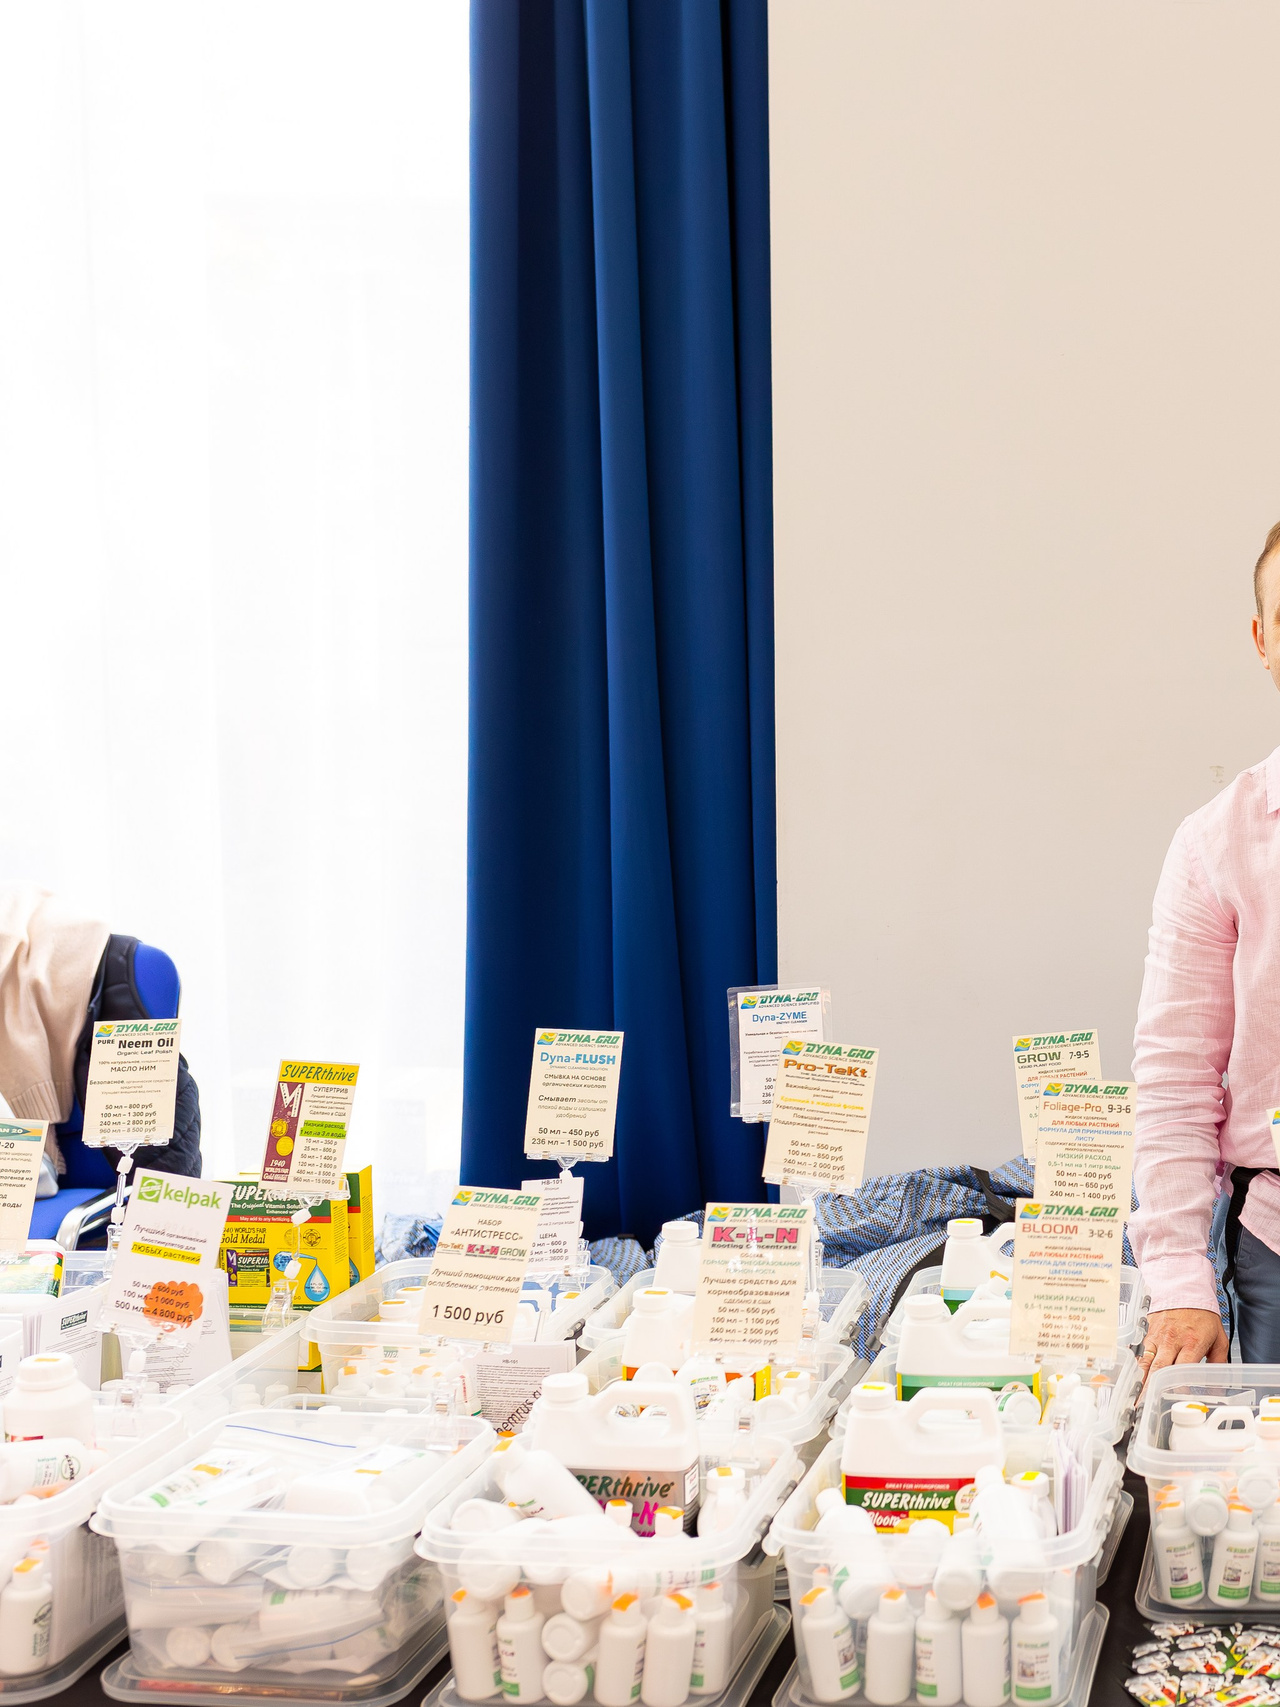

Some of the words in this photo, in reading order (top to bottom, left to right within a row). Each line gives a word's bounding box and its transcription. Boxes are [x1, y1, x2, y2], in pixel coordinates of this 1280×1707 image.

[759, 992, 819, 1004] DYNA-GRO
[753, 1011, 807, 1023] Dyna-ZYME
[116, 1023, 178, 1032] DYNA-GRO
[119, 1040, 152, 1048] Neem
[157, 1038, 173, 1047] Oil
[558, 1033, 620, 1044] DYNA-GRO
[1034, 1032, 1093, 1045] DYNA-GRO
[806, 1043, 876, 1059] DYNA-GRO
[540, 1052, 616, 1065] Dyna-FLUSH
[1017, 1051, 1061, 1064] GROW
[1069, 1051, 1089, 1059] 7-9-5
[282, 1064, 355, 1081] SUPERthrive
[1065, 1084, 1130, 1095] DYNA-GRO
[538, 1095, 576, 1103] Смывает
[1043, 1101, 1102, 1113] Foliage-Pro
[1108, 1105, 1131, 1113] 9-3-6
[1085, 1154, 1111, 1162] РАСХОД
[163, 1183, 222, 1209] kelpak
[474, 1192, 541, 1206] DYNA-GRO
[733, 1208, 808, 1218] DYNA-GRO
[1044, 1205, 1119, 1217] DYNA-GRO
[451, 1228, 523, 1241] «АНТИСТРЕСС»
[713, 1227, 798, 1243] K-L-N
[1022, 1223, 1078, 1234] BLOOM
[1089, 1229, 1113, 1238] 3-12-6
[241, 1234, 265, 1244] Medal
[703, 1276, 736, 1285] Лучшее
[739, 1277, 779, 1286] средство
[707, 1288, 790, 1296] корнеобразования
[115, 1301, 130, 1310] 500
[132, 1304, 144, 1312] мл
[160, 1309, 175, 1318] 800
[177, 1312, 193, 1323] руб
[432, 1305, 438, 1318] 1
[443, 1306, 471, 1321] 500
[474, 1310, 504, 1326] руб
[576, 1475, 671, 1498] PERthrive
[862, 1492, 953, 1510] SUPERthrive
